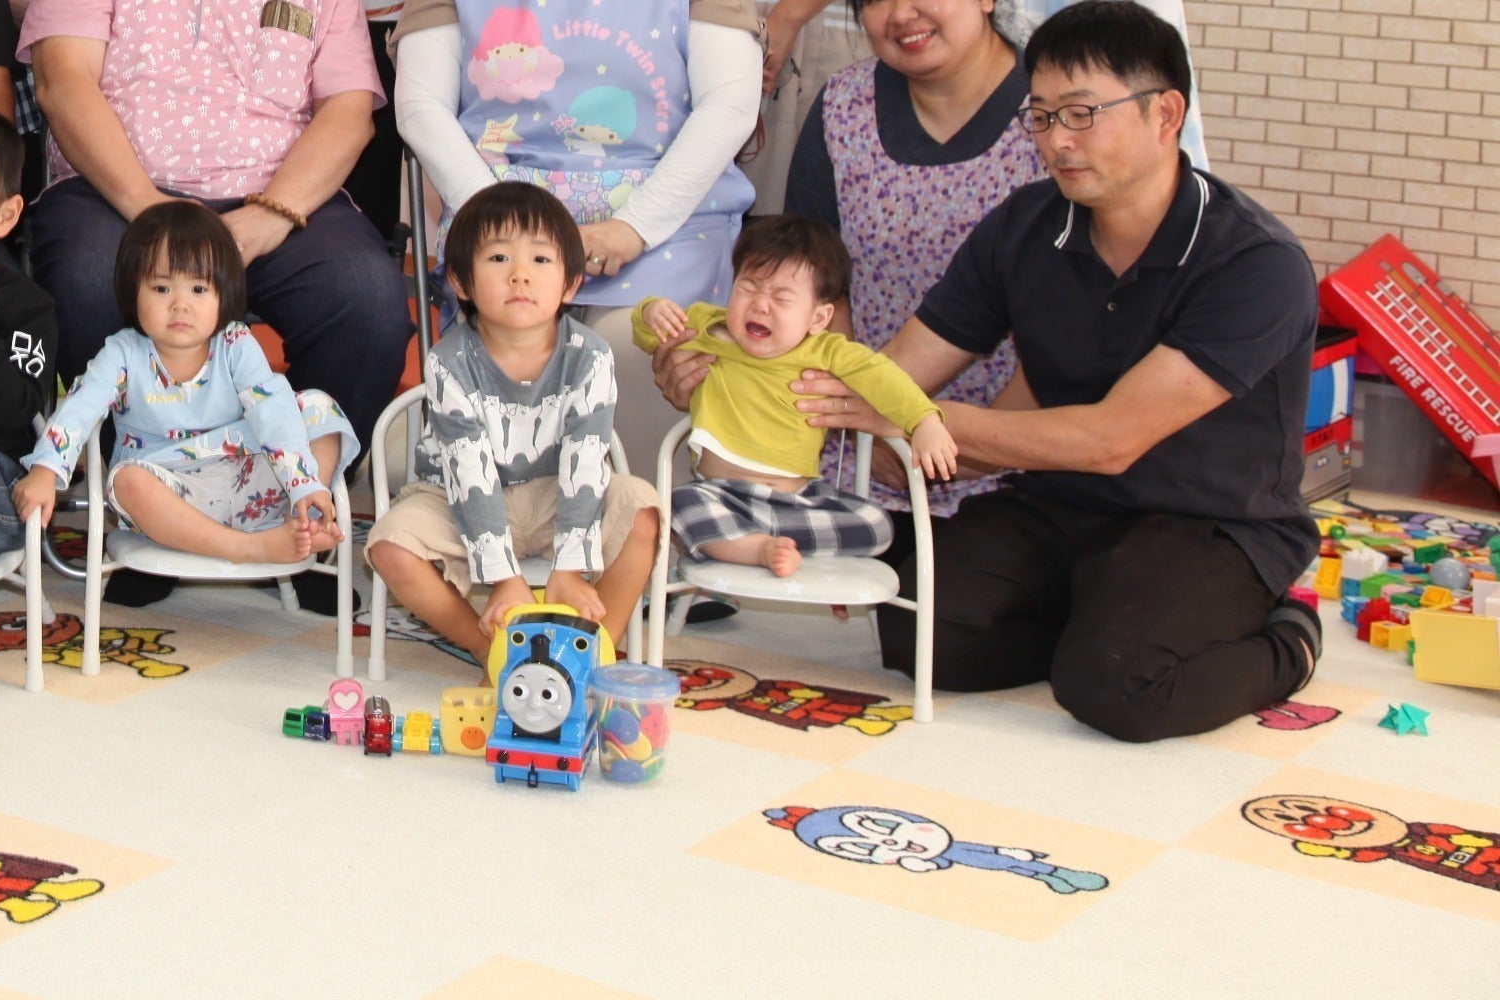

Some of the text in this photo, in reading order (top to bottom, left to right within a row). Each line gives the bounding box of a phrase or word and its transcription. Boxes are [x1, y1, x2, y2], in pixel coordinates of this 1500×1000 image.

[553, 19, 669, 133] Little Twin Stars
[1389, 354, 1478, 443] FIRE RESCUE
